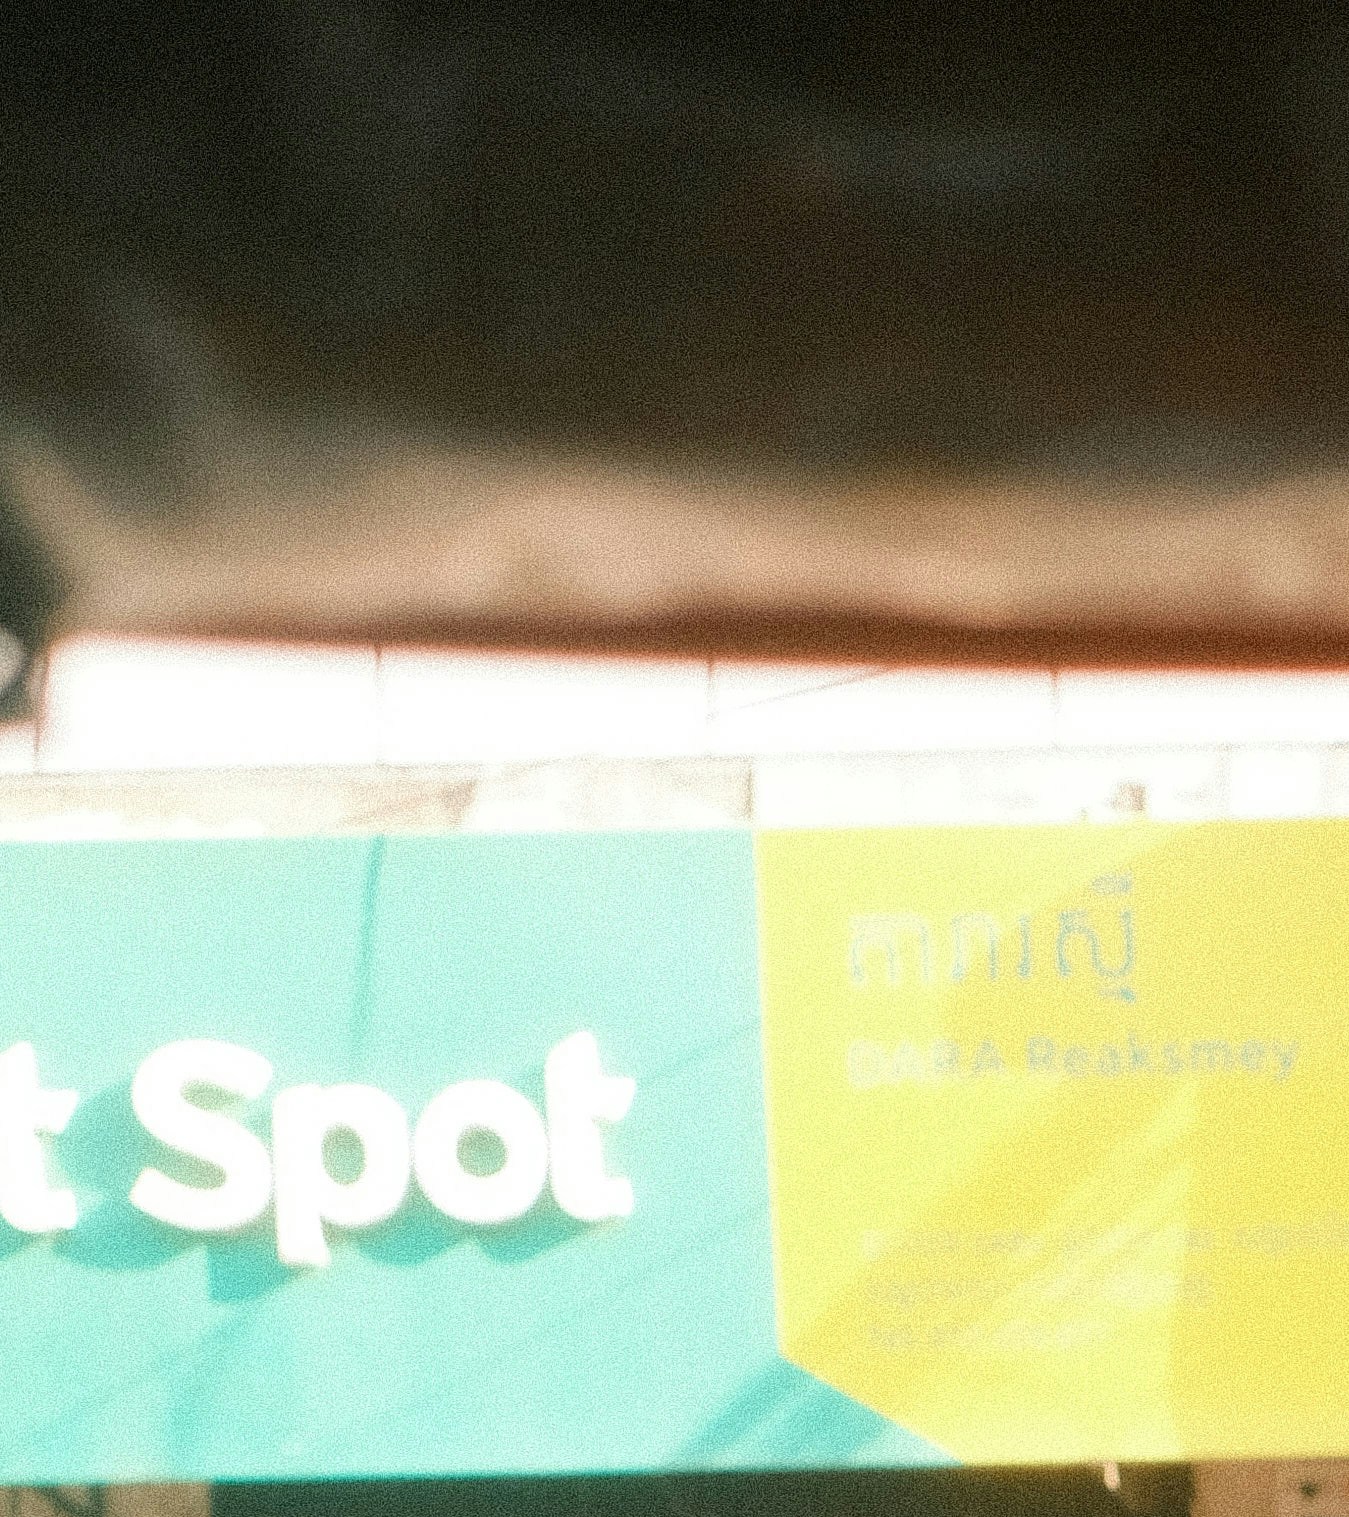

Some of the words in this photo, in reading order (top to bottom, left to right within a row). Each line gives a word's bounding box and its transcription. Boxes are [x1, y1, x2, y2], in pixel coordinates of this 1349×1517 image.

[847, 1036, 1007, 1088] DARA
[1025, 1033, 1299, 1084] Reaksmey
[130, 1030, 637, 1268] Spot
